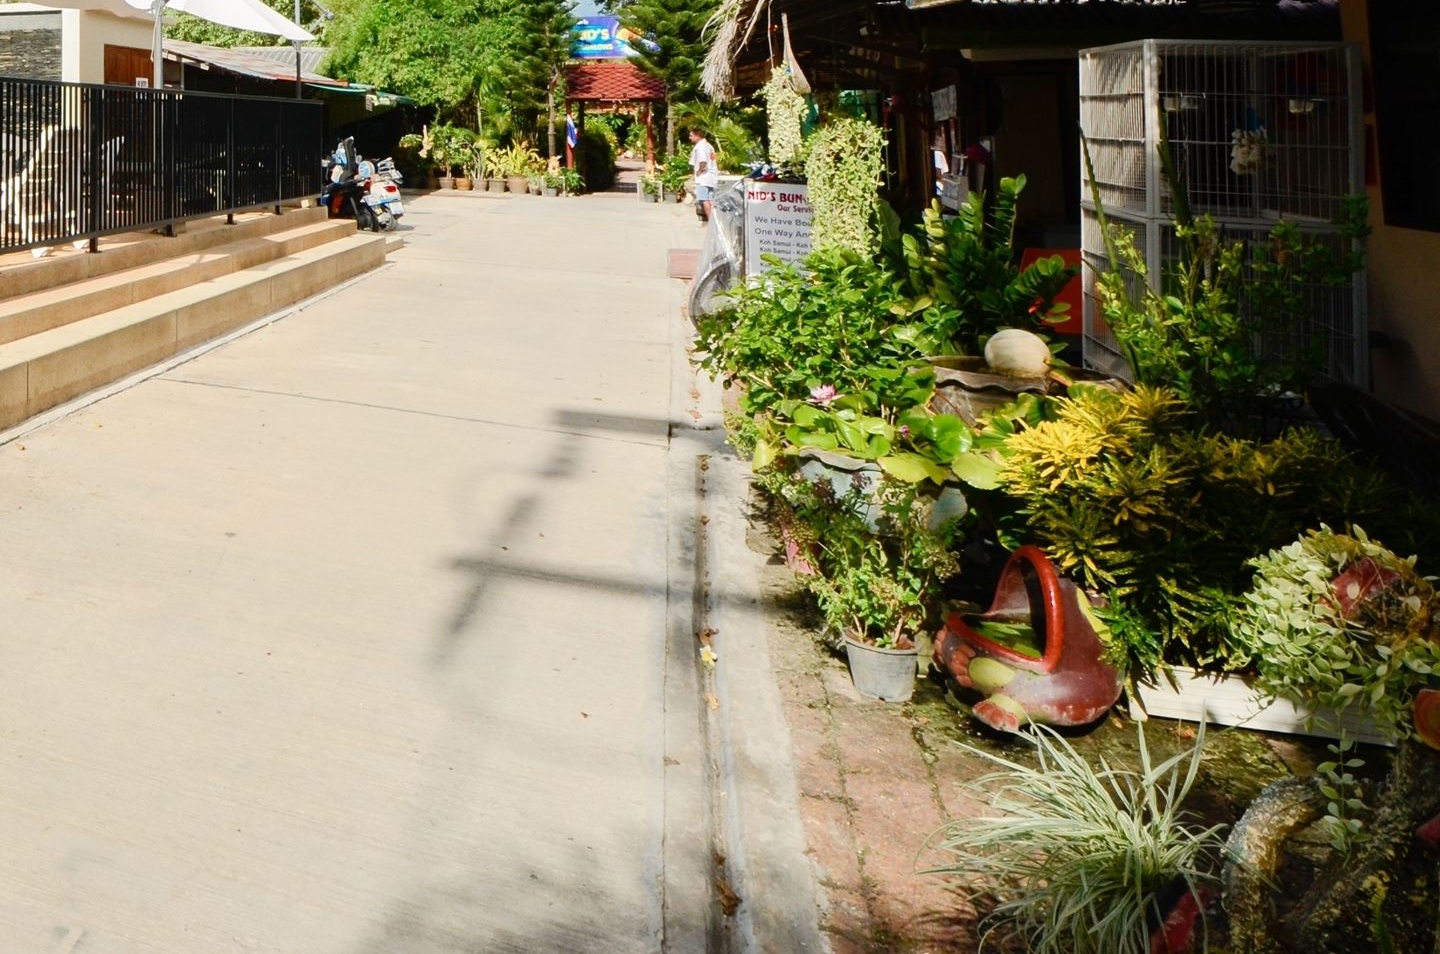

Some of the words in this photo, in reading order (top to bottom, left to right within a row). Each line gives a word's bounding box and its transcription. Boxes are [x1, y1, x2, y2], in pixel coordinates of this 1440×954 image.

[748, 191, 776, 202] NID'S
[777, 204, 791, 212] Our
[755, 216, 768, 224] We
[771, 217, 793, 225] Have
[755, 227, 772, 235] One
[775, 229, 793, 239] Way
